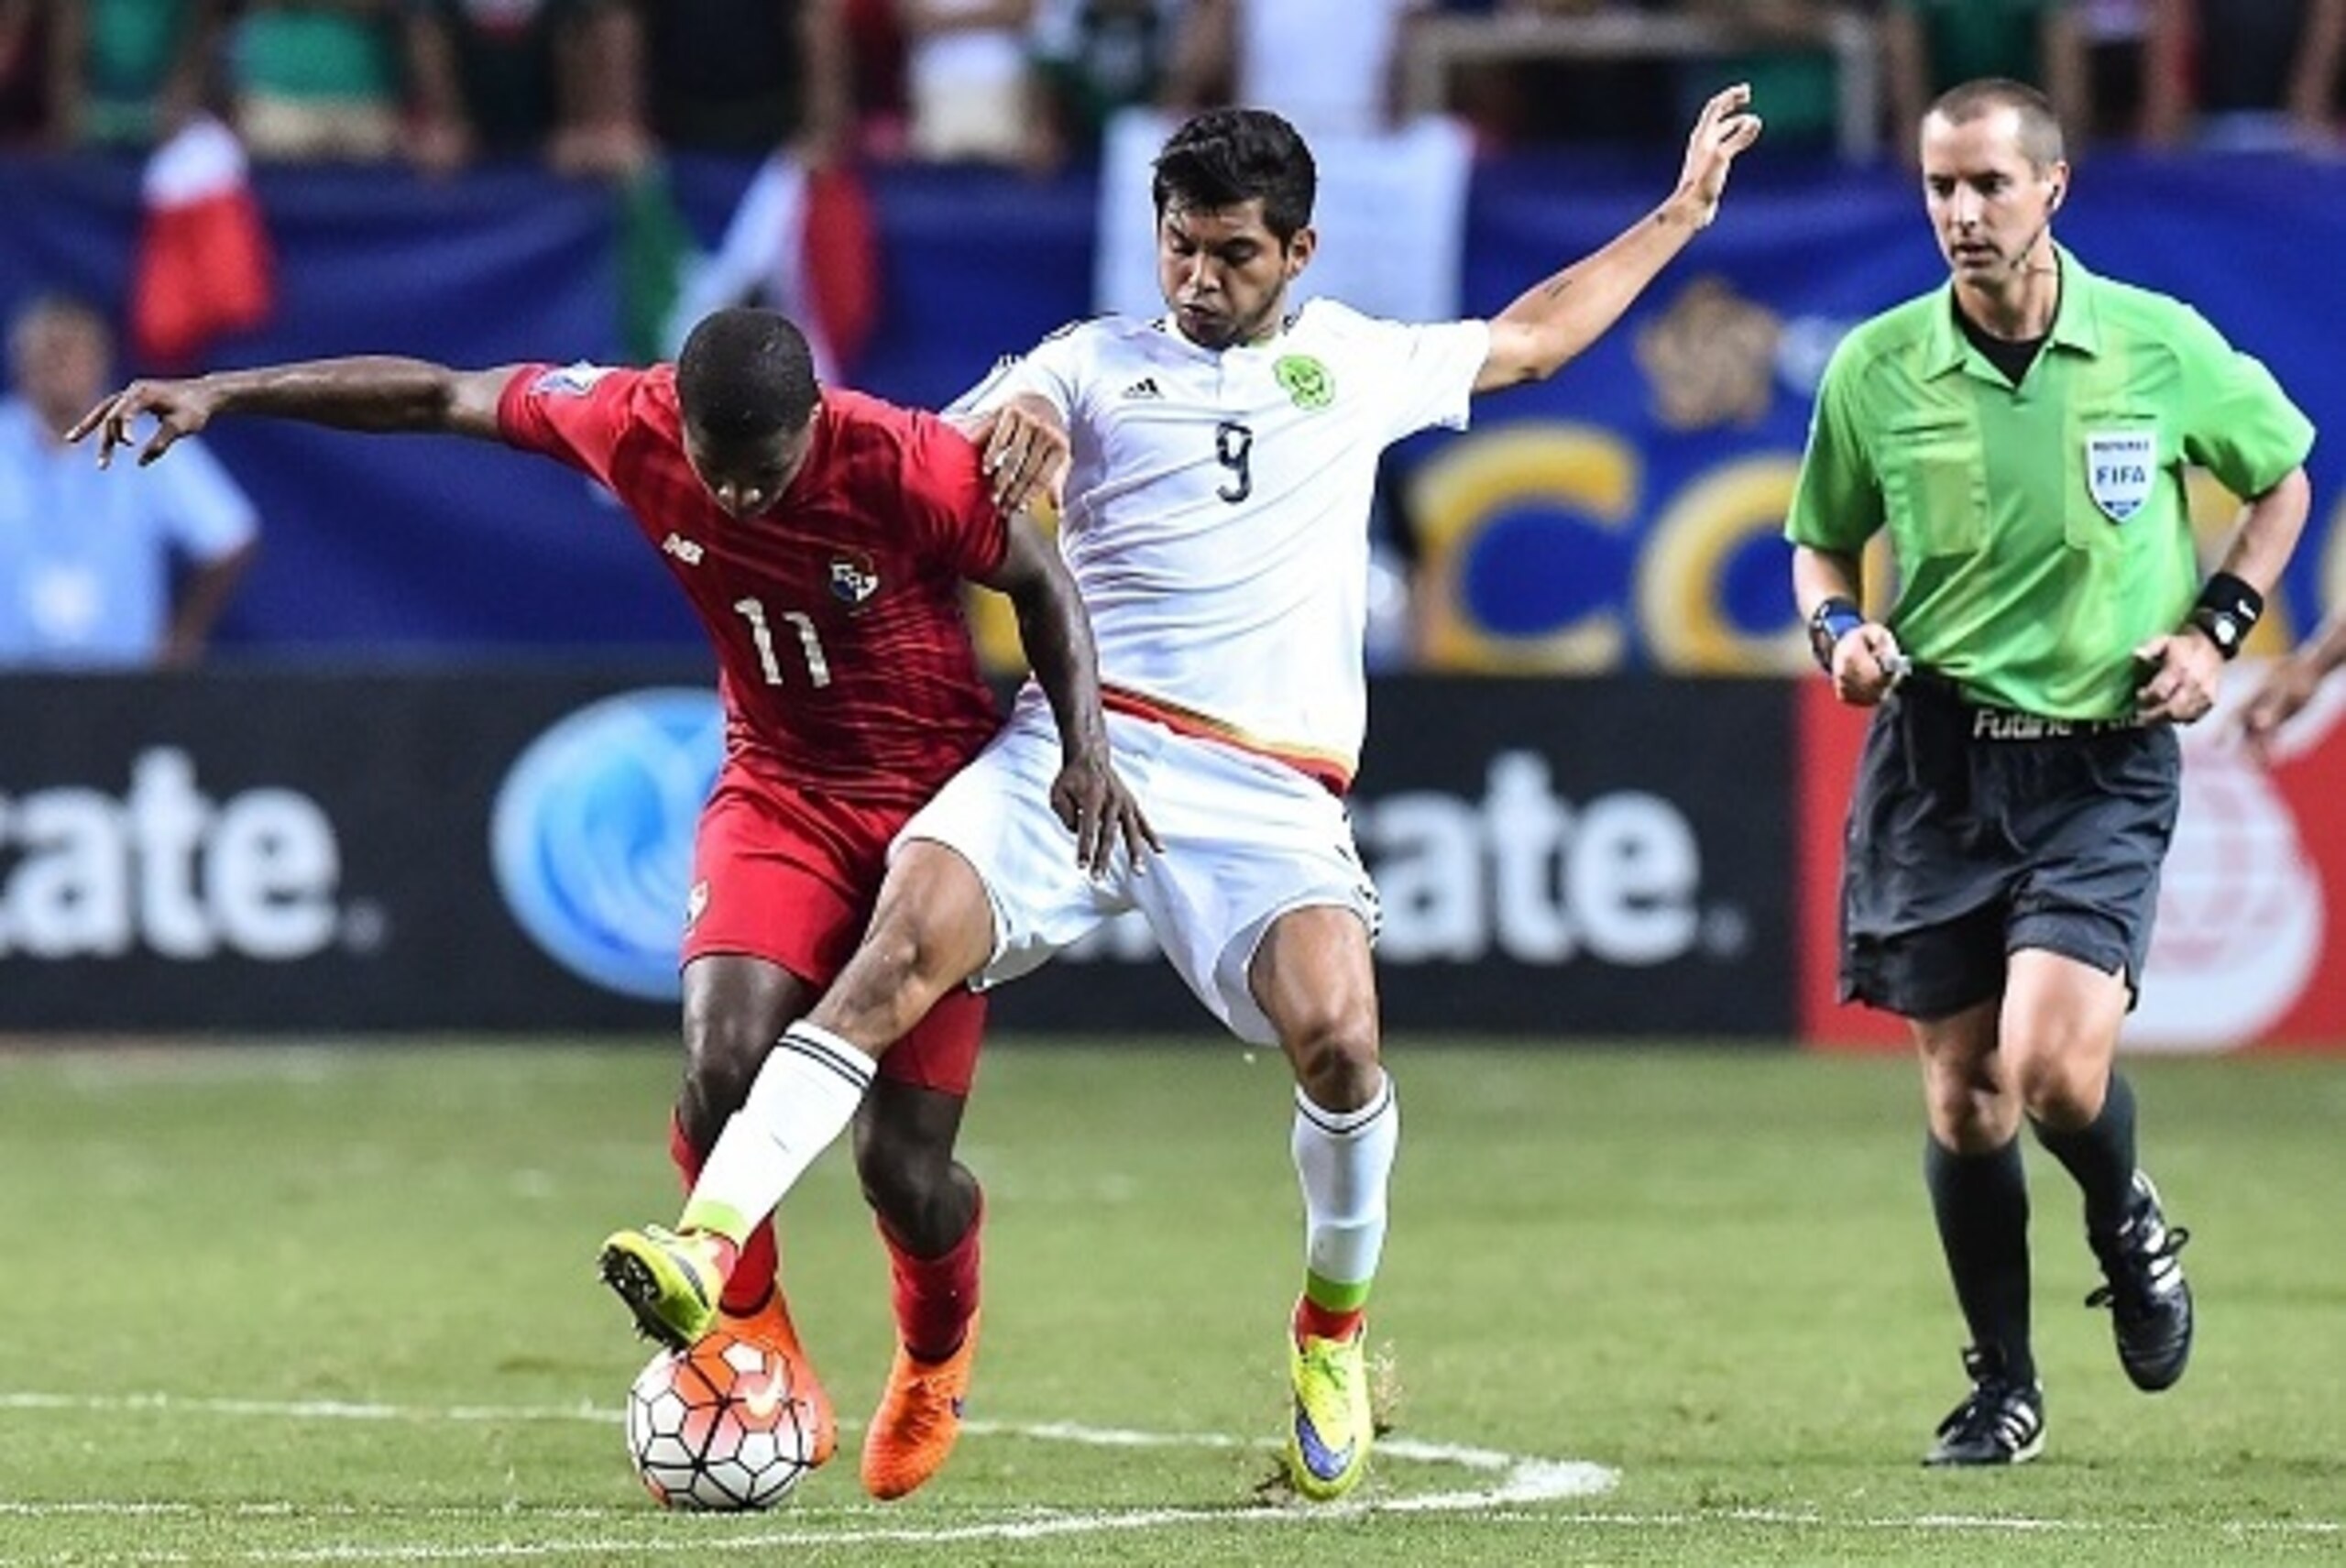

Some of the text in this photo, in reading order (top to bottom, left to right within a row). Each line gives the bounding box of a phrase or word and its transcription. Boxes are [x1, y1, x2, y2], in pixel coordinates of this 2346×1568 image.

[1216, 422, 1253, 504] 9
[2096, 465, 2146, 485] FIFA
[734, 597, 830, 687] 11
[0, 746, 340, 960] ate
[1356, 750, 1702, 966] ate
